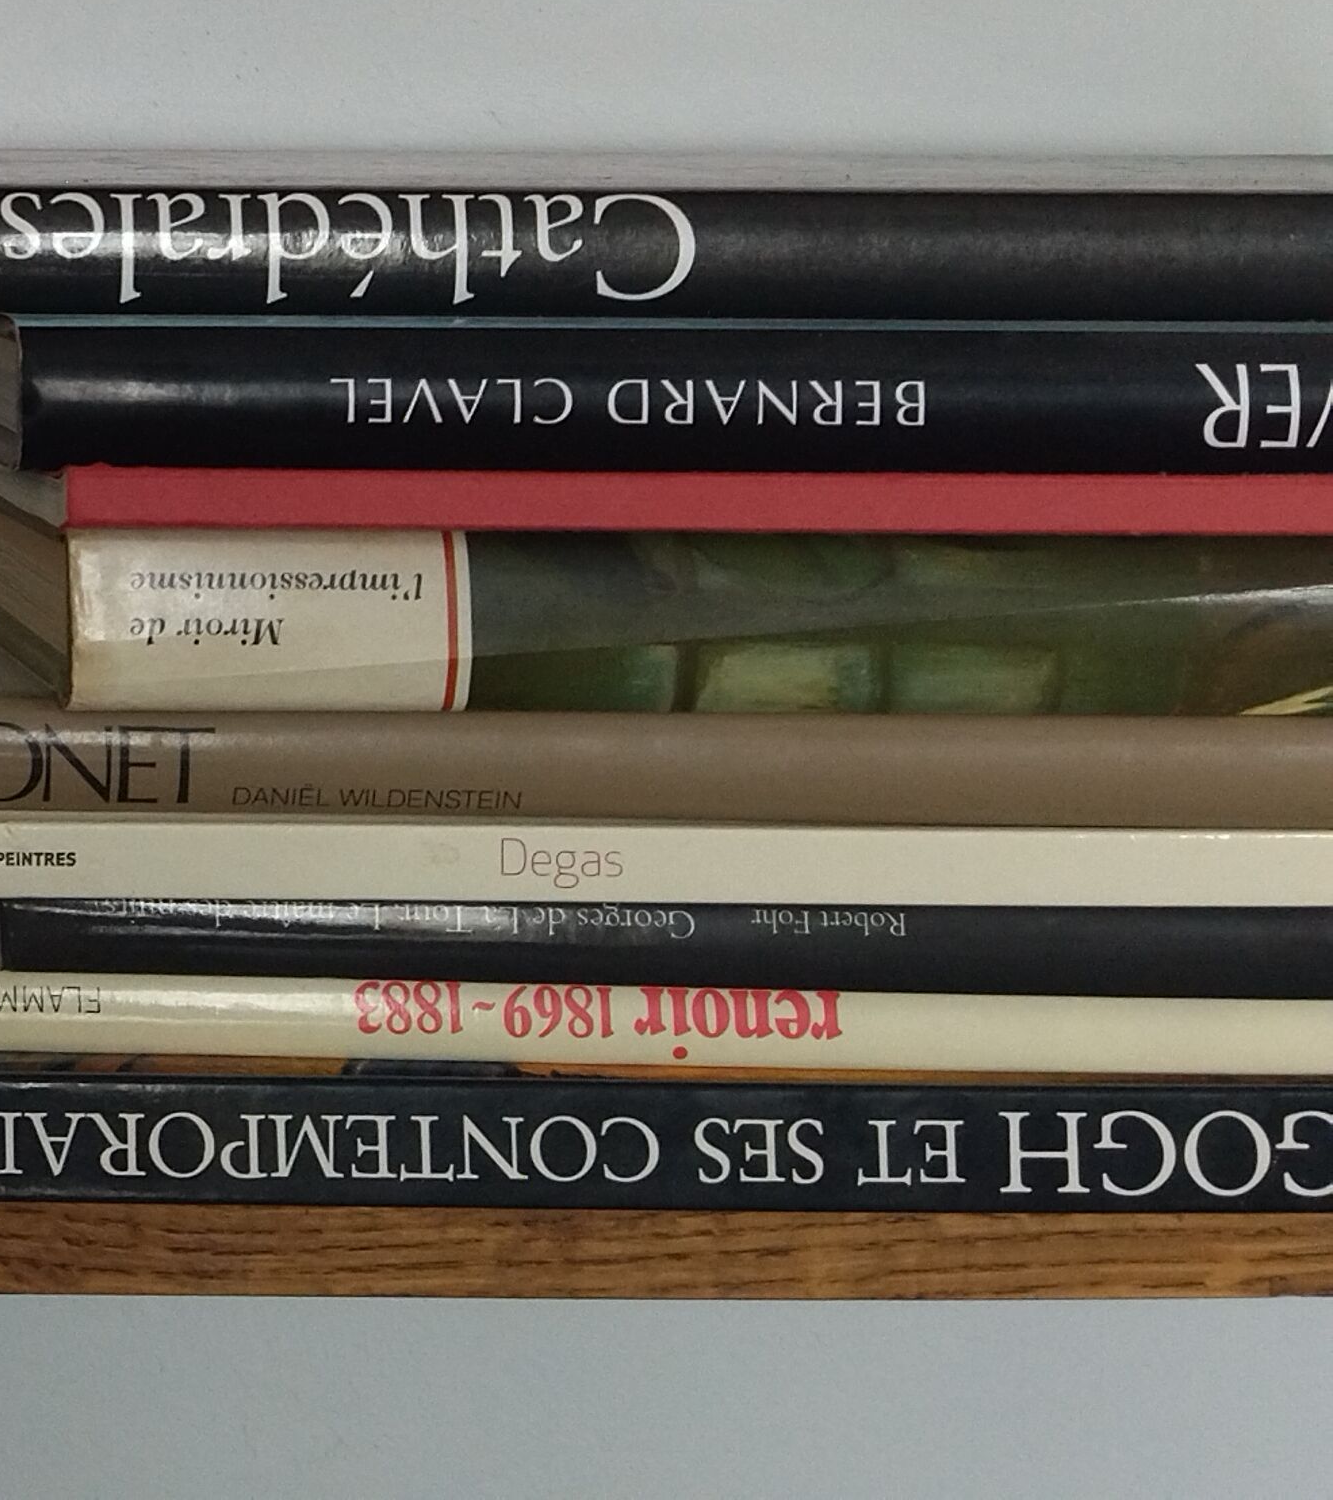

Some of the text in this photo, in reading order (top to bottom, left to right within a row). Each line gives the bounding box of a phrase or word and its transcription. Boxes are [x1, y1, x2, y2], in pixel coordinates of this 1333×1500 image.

[329, 376, 928, 427] BERNARD CLAVEL
[129, 570, 425, 602] l'impressionnisme
[129, 615, 285, 647] Miroir de
[337, 788, 524, 811] WILDENSTEIN
[499, 837, 625, 889] Degas
[532, 905, 566, 935] de
[576, 902, 696, 939] Georges
[750, 908, 908, 937] Robert Fohr
[632, 985, 845, 1061] renoir
[693, 1116, 826, 1186] SES
[857, 1118, 966, 1186] ET
[998, 1108, 1333, 1198] GOGH
